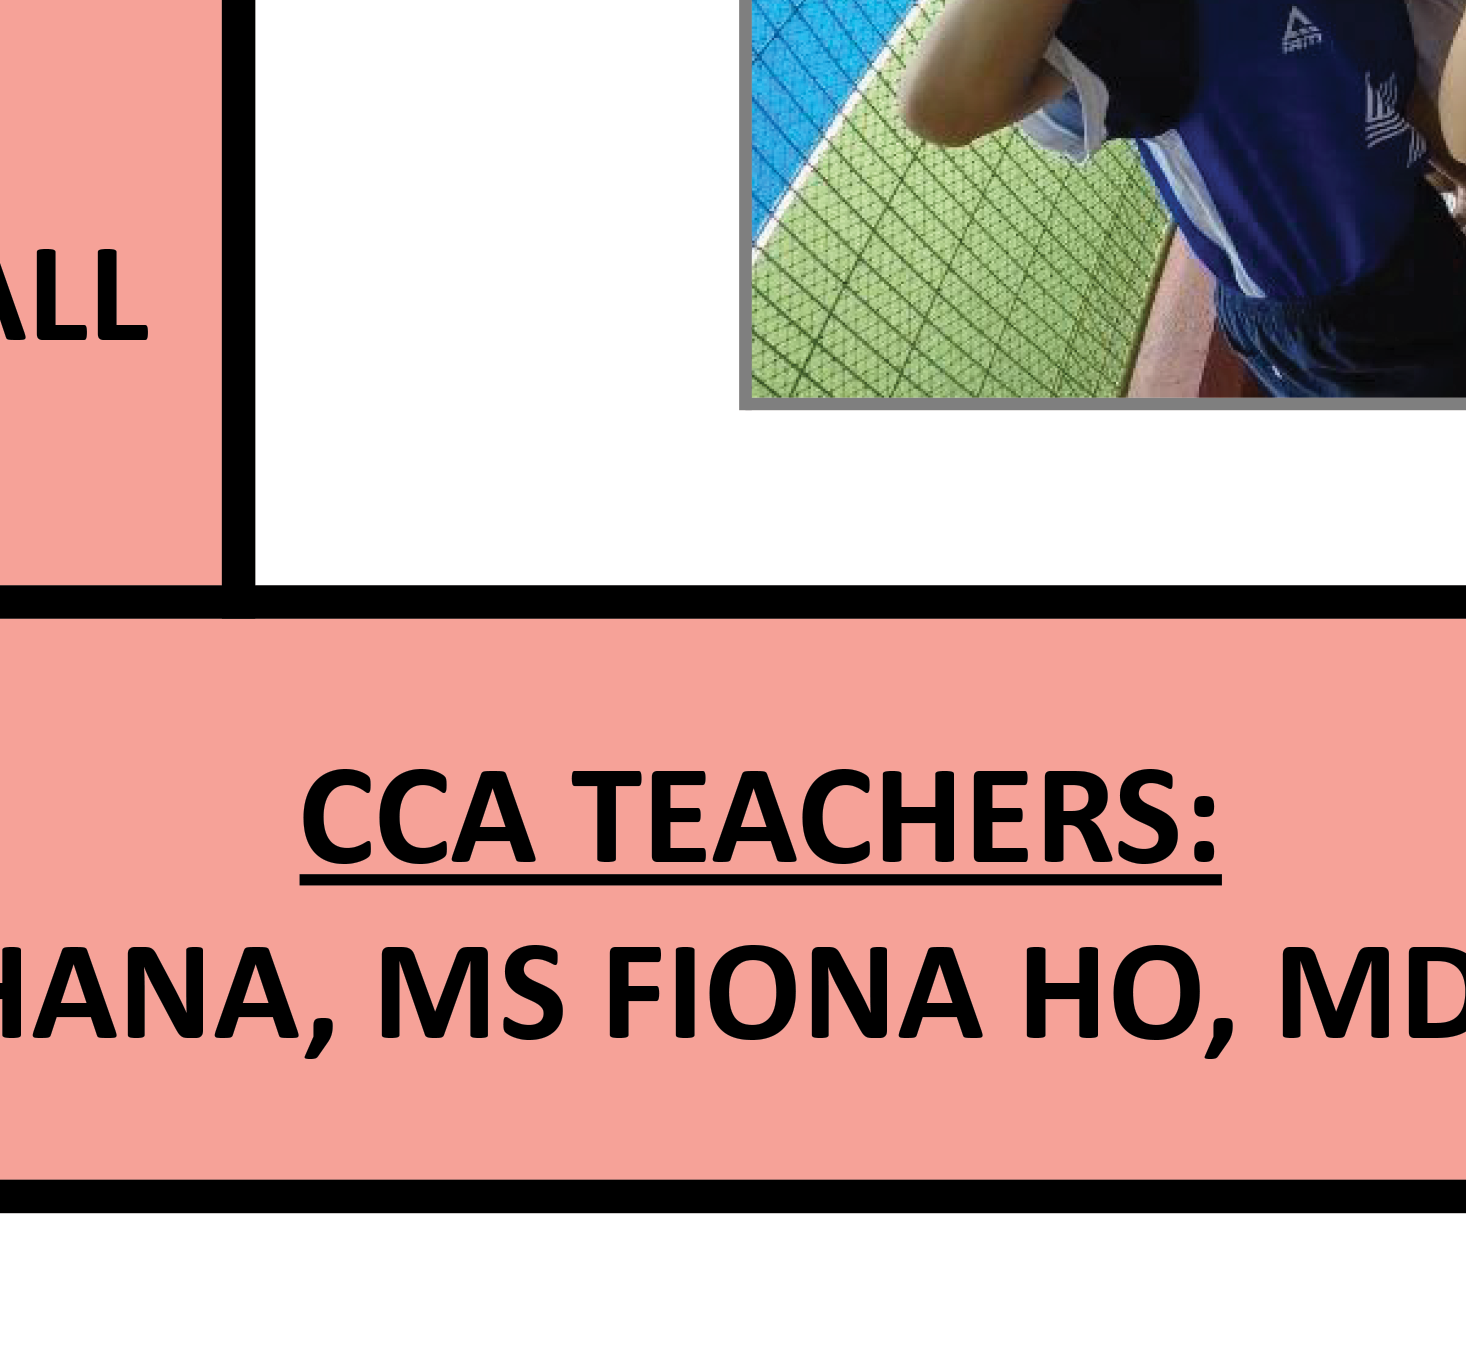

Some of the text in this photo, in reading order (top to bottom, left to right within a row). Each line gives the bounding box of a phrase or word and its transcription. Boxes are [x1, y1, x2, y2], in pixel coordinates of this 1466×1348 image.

[304, 769, 1214, 864] CCA TEACHERS:
[382, 945, 563, 1040] MS
[610, 945, 983, 1040] FIONA
[1027, 945, 1233, 1059] HO,
